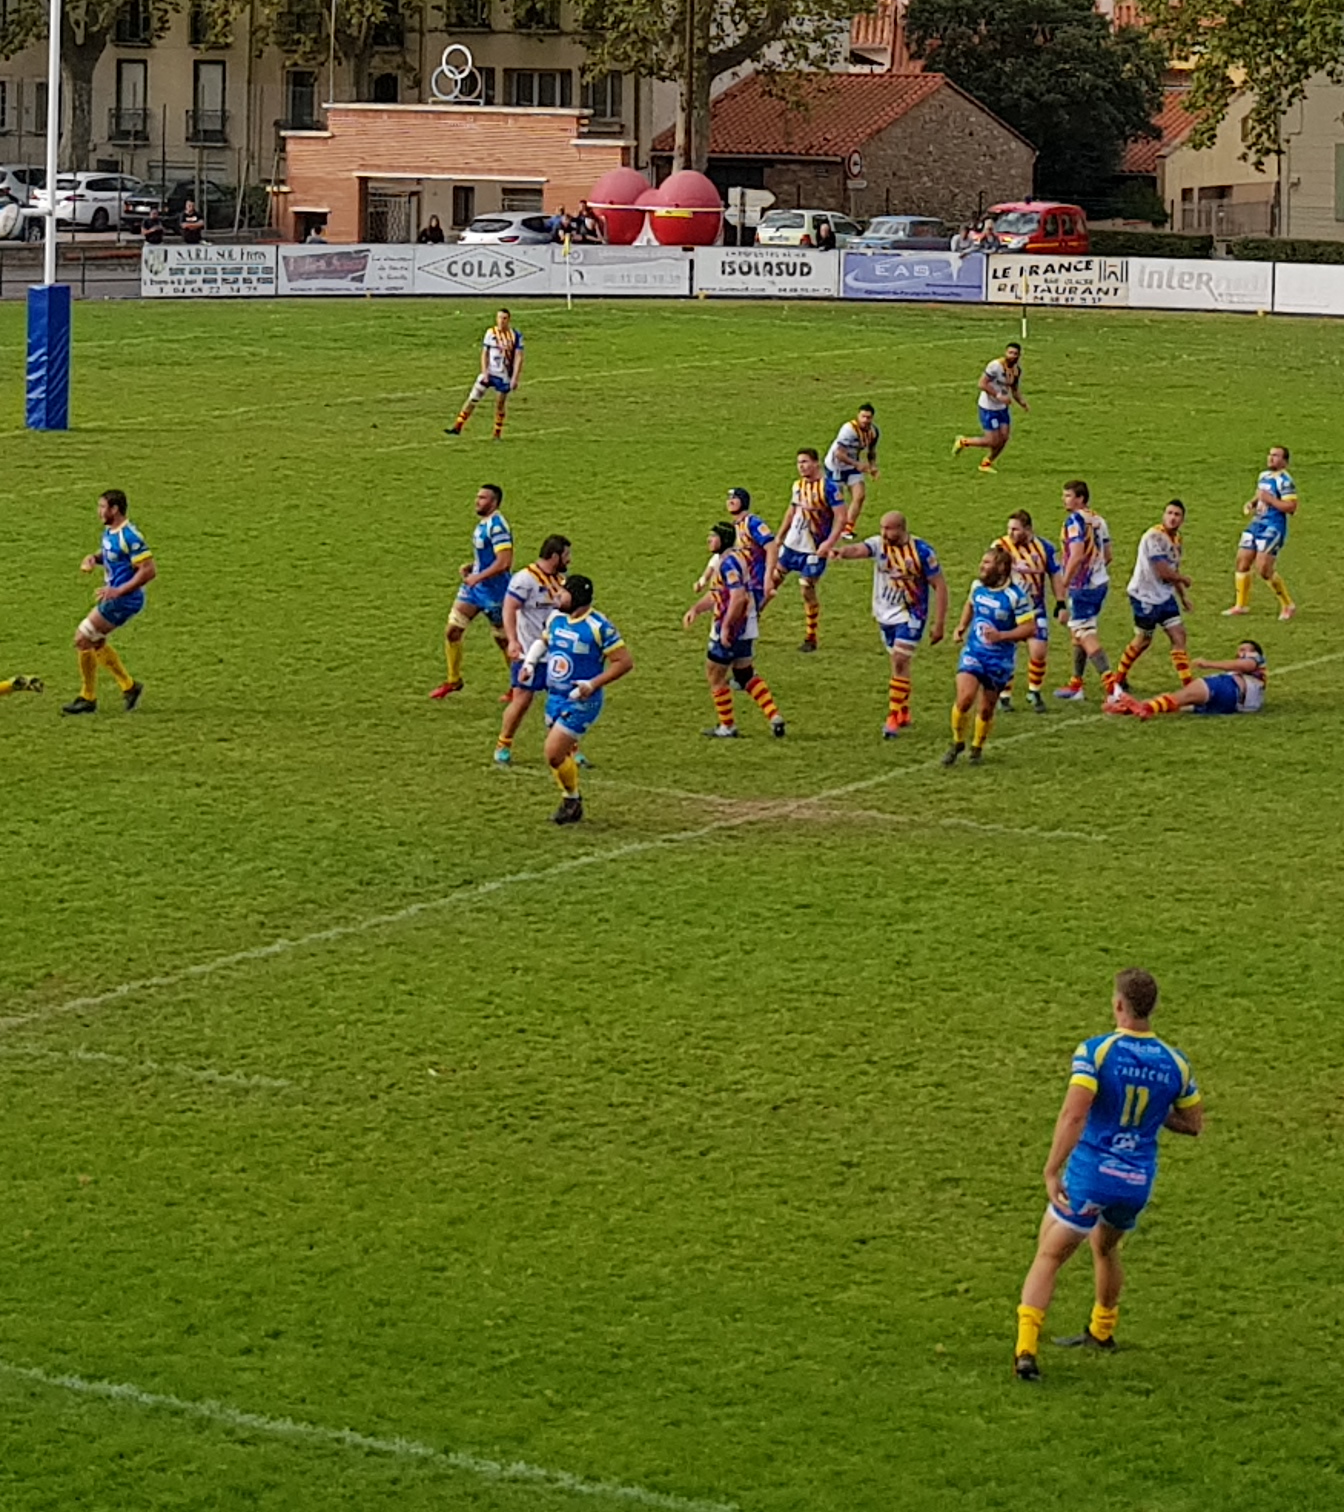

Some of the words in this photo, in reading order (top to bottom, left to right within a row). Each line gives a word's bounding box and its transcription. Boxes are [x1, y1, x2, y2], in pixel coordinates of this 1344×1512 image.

[447, 260, 515, 278] COLAS
[721, 260, 812, 277] ISOLASUD
[992, 266, 1011, 279] LE
[997, 283, 1120, 297] RETAURANT
[1120, 1084, 1149, 1126] 11
